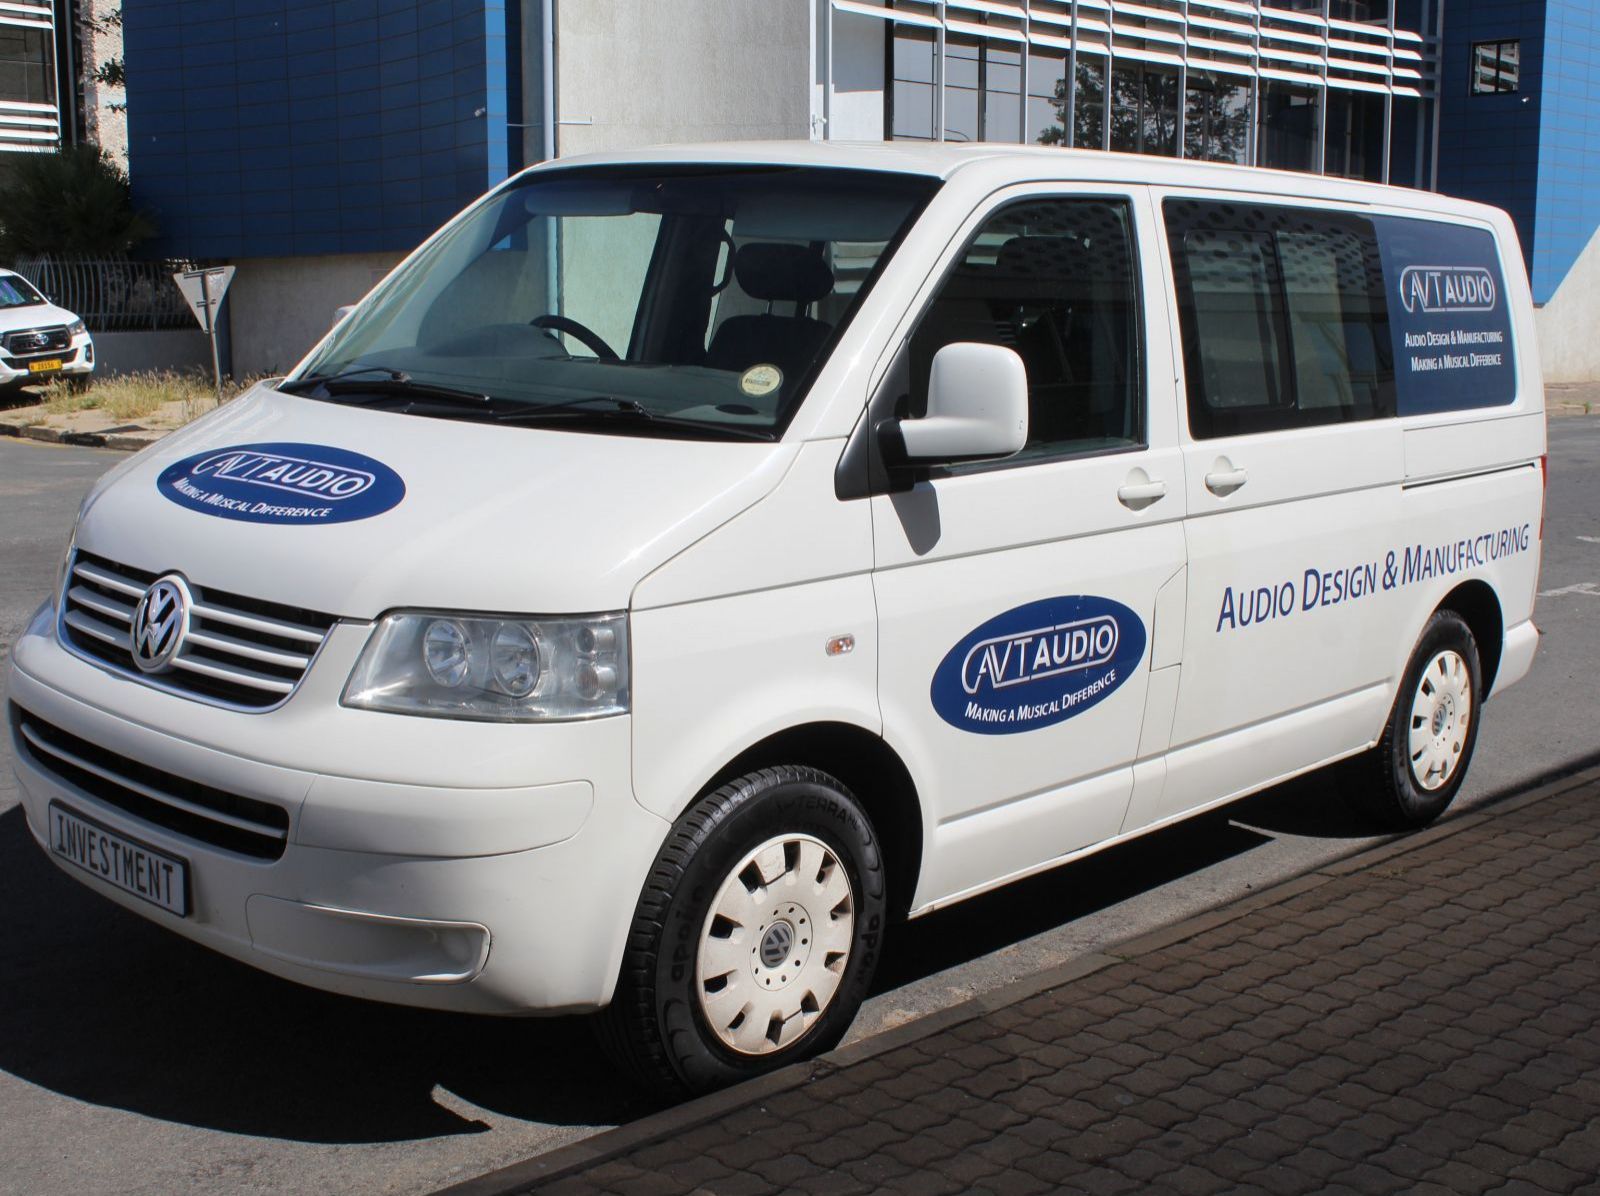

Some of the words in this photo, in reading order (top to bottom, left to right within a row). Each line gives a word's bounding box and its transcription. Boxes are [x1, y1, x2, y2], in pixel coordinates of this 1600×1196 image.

[1445, 275, 1492, 304] AUDIO
[1405, 332, 1426, 347] AUDIO
[1427, 331, 1450, 346] DESIGN
[1451, 331, 1457, 344] &
[1457, 330, 1503, 344] MANUFACTURING
[1411, 356, 1437, 372] MAKING
[1438, 360, 1443, 370] A
[1444, 355, 1470, 370] MUSICAL
[1470, 353, 1501, 367] DIFFERENCE
[172, 477, 200, 500] MAKING
[195, 492, 205, 501] A
[204, 493, 251, 513] MUSICAL
[250, 502, 333, 518] DIFFERENCE
[257, 463, 366, 495] AUDIO
[1216, 581, 1295, 632] AUDIO
[1301, 562, 1377, 612] DESIGN
[1382, 550, 1398, 590] &
[1401, 523, 1530, 585] MANUFACTURING
[1032, 625, 1114, 671] AUDIO
[965, 701, 1007, 722] MAKING
[1008, 711, 1015, 721] A
[1017, 702, 1060, 721] MUSICAL
[1061, 668, 1116, 710] DIFFERENCE
[57, 814, 173, 904] INVESTMENT
